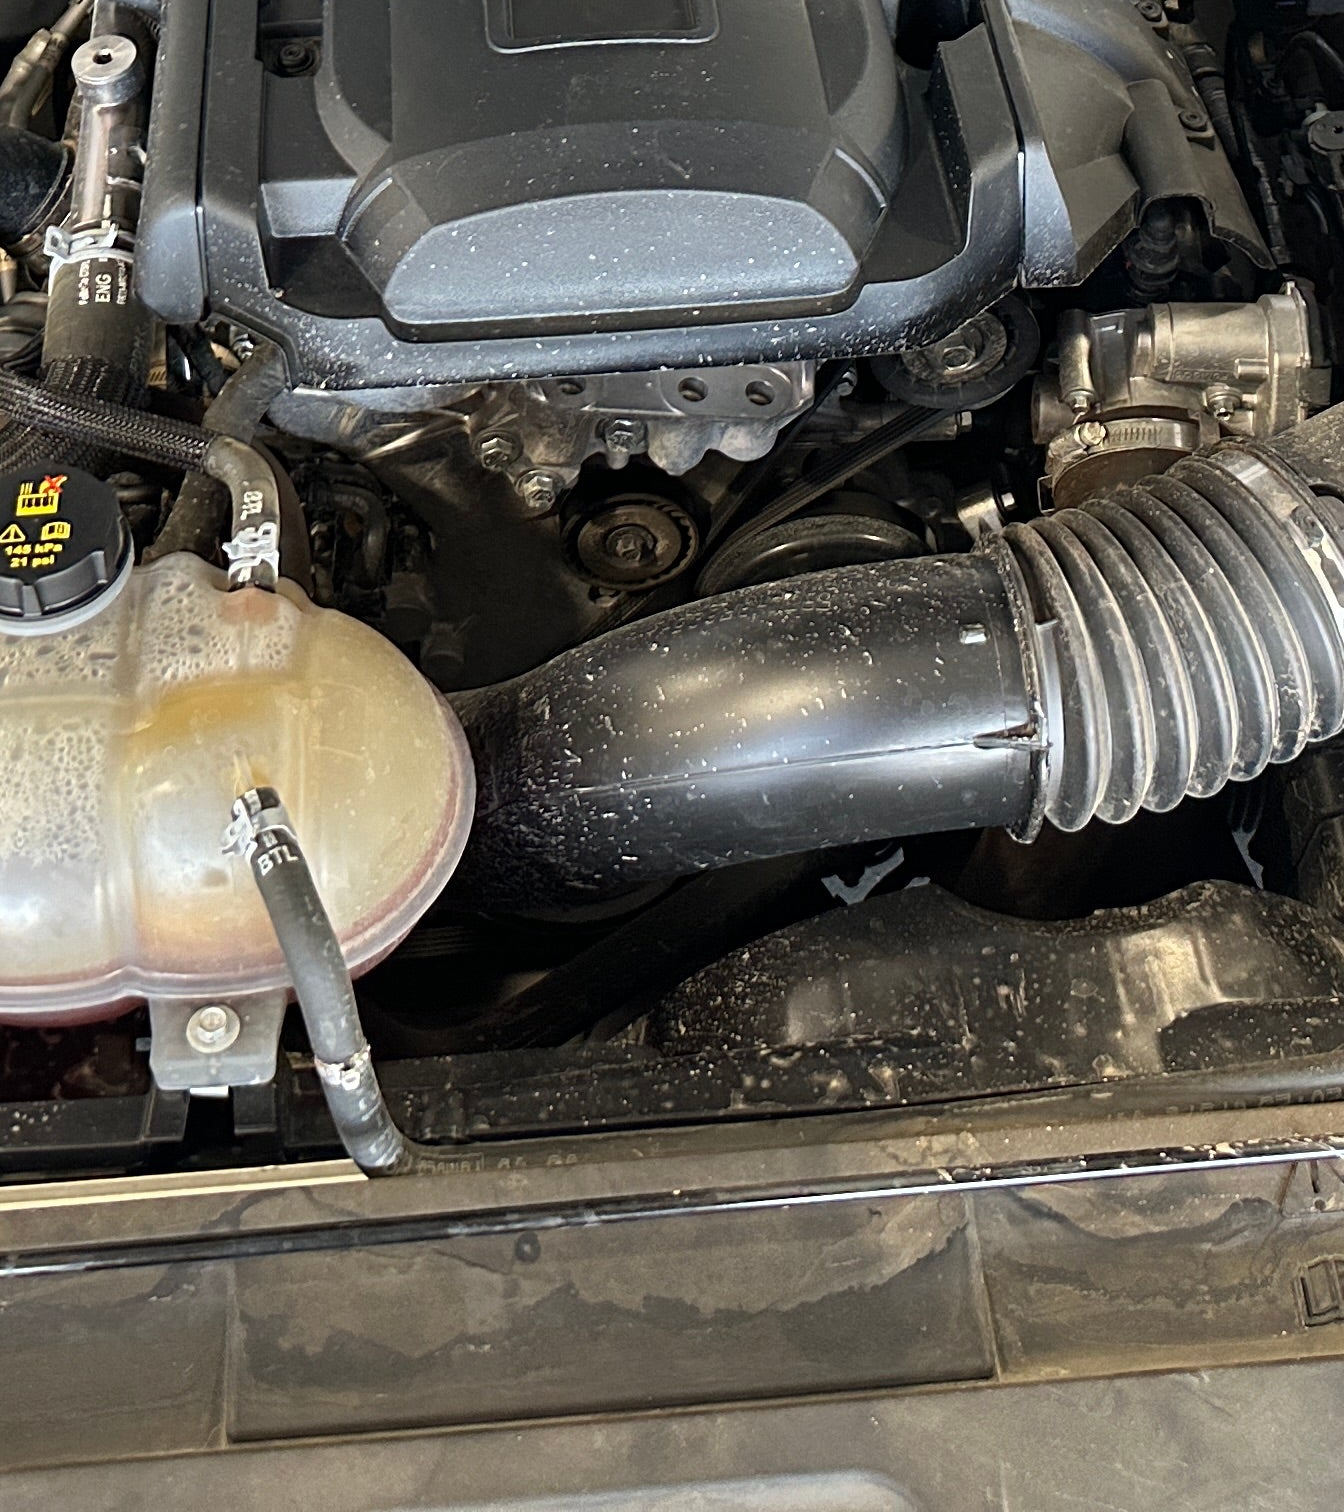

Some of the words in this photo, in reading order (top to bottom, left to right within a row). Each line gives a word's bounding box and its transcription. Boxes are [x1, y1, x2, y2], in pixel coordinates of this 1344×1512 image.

[95, 273, 111, 303] ENG
[5, 544, 32, 555] 145
[35, 543, 63, 554] kPa
[10, 556, 28, 568] 21
[258, 845, 299, 876] BTL
